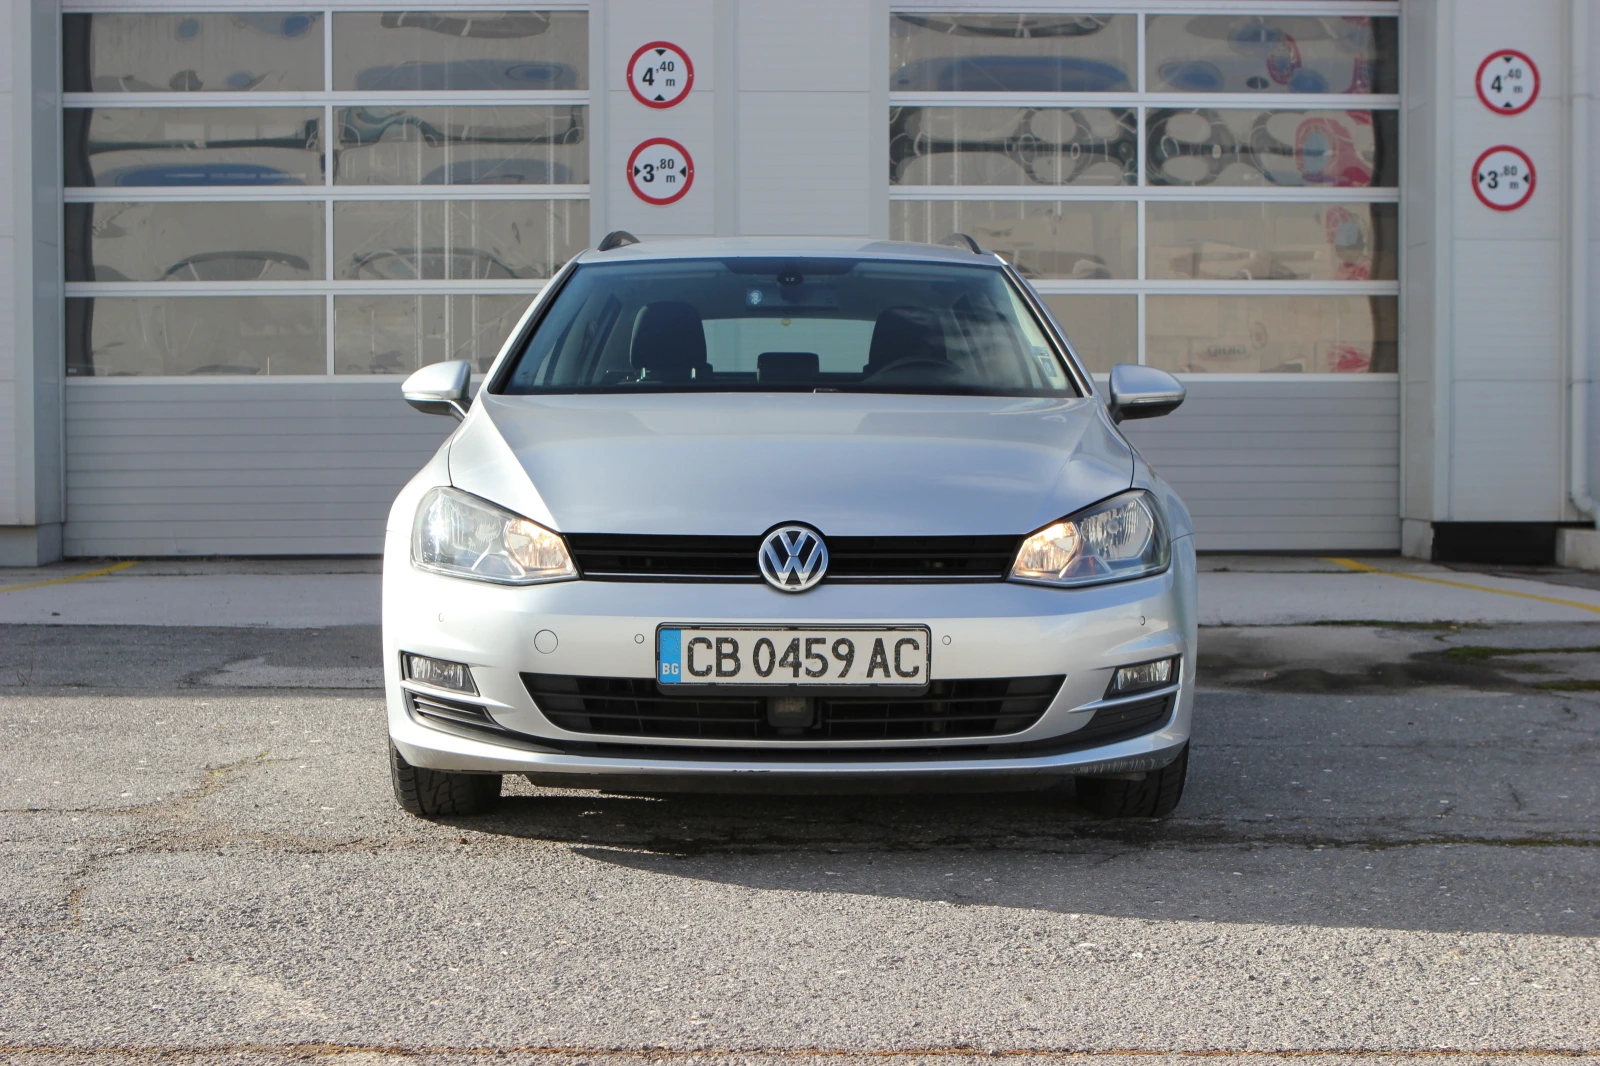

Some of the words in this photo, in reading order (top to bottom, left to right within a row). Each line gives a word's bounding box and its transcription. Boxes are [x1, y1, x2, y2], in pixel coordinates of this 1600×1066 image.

[665, 78, 676, 87] m
[665, 175, 676, 183] m
[1509, 181, 1519, 189] m
[687, 637, 741, 678] CB
[752, 637, 855, 678] 0459
[866, 637, 920, 678] AC
[662, 662, 679, 675] BG
